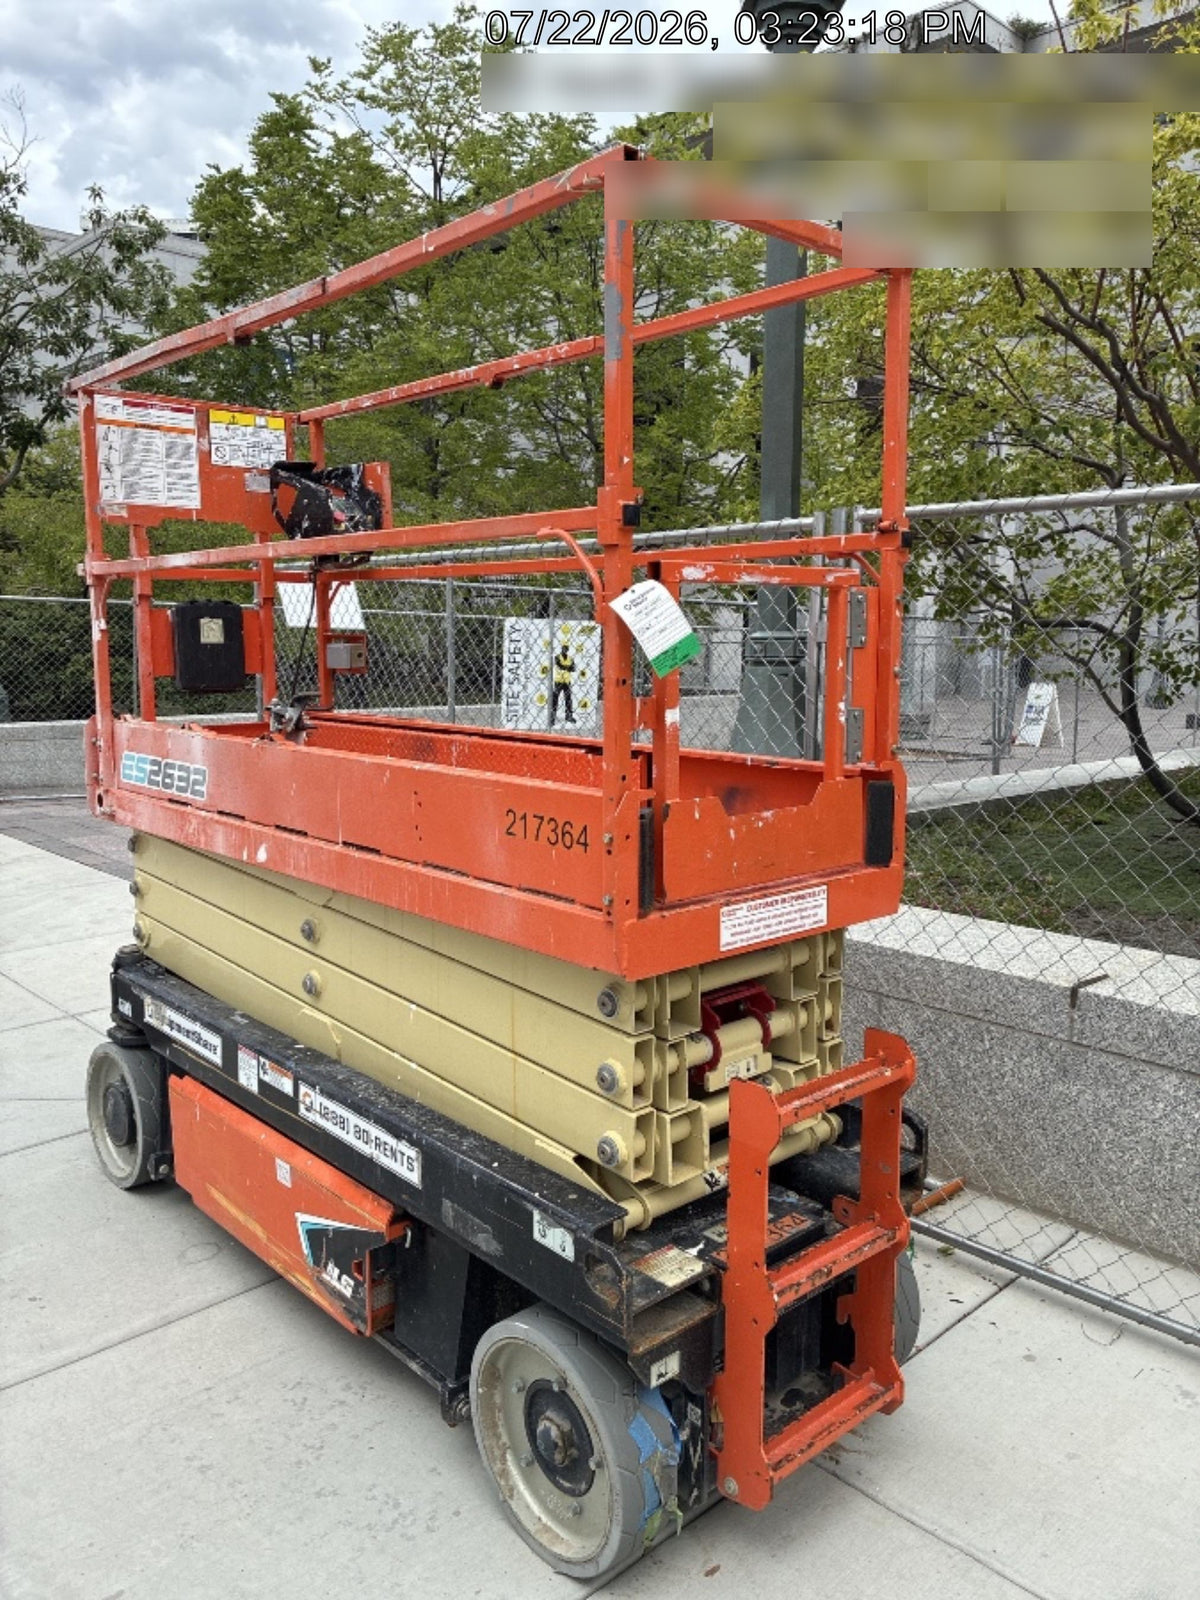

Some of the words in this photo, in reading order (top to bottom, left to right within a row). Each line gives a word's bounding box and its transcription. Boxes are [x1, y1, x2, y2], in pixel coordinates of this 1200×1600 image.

[507, 624, 522, 685] SAFETY
[505, 690, 521, 723] SITE
[121, 751, 208, 800] ES2632
[505, 808, 589, 854] 217364
